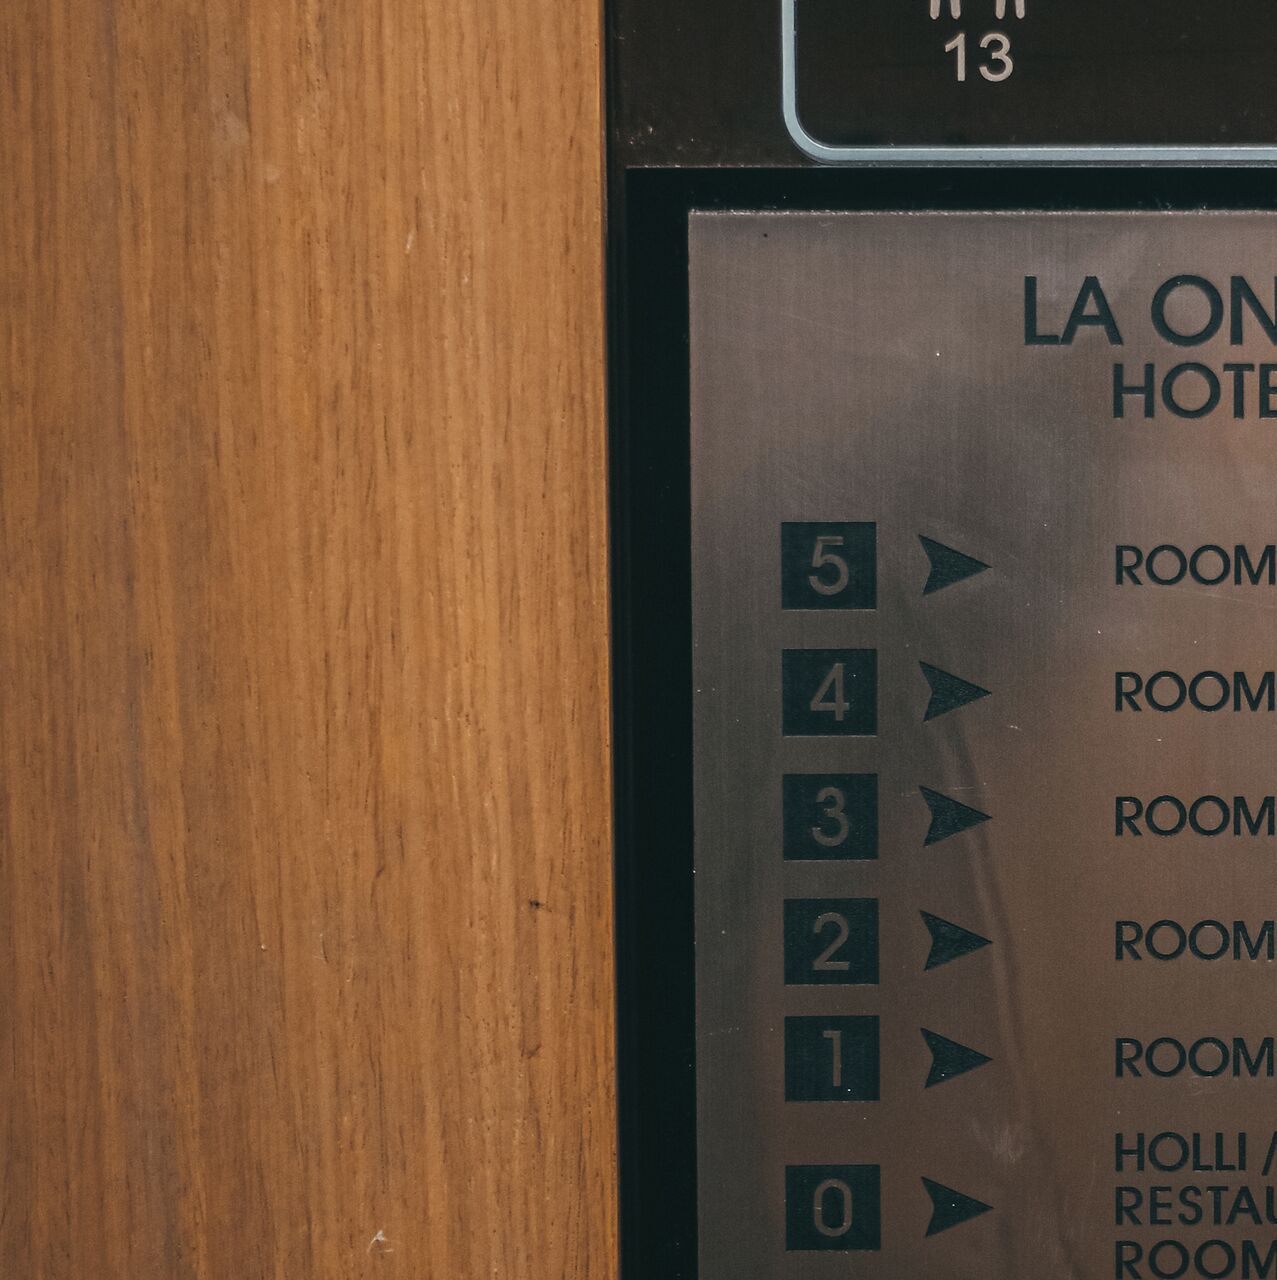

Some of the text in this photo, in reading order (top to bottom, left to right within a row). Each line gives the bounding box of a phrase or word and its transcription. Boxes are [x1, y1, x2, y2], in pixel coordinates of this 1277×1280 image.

[944, 32, 1014, 82] 13
[1023, 275, 1125, 346] LA
[808, 534, 850, 596] 5
[809, 661, 851, 721] 4
[811, 785, 850, 847] 3
[812, 910, 851, 971] 2
[822, 1029, 843, 1087] 1
[1114, 1131, 1247, 1173] HOLLI
[812, 1178, 853, 1237] 0
